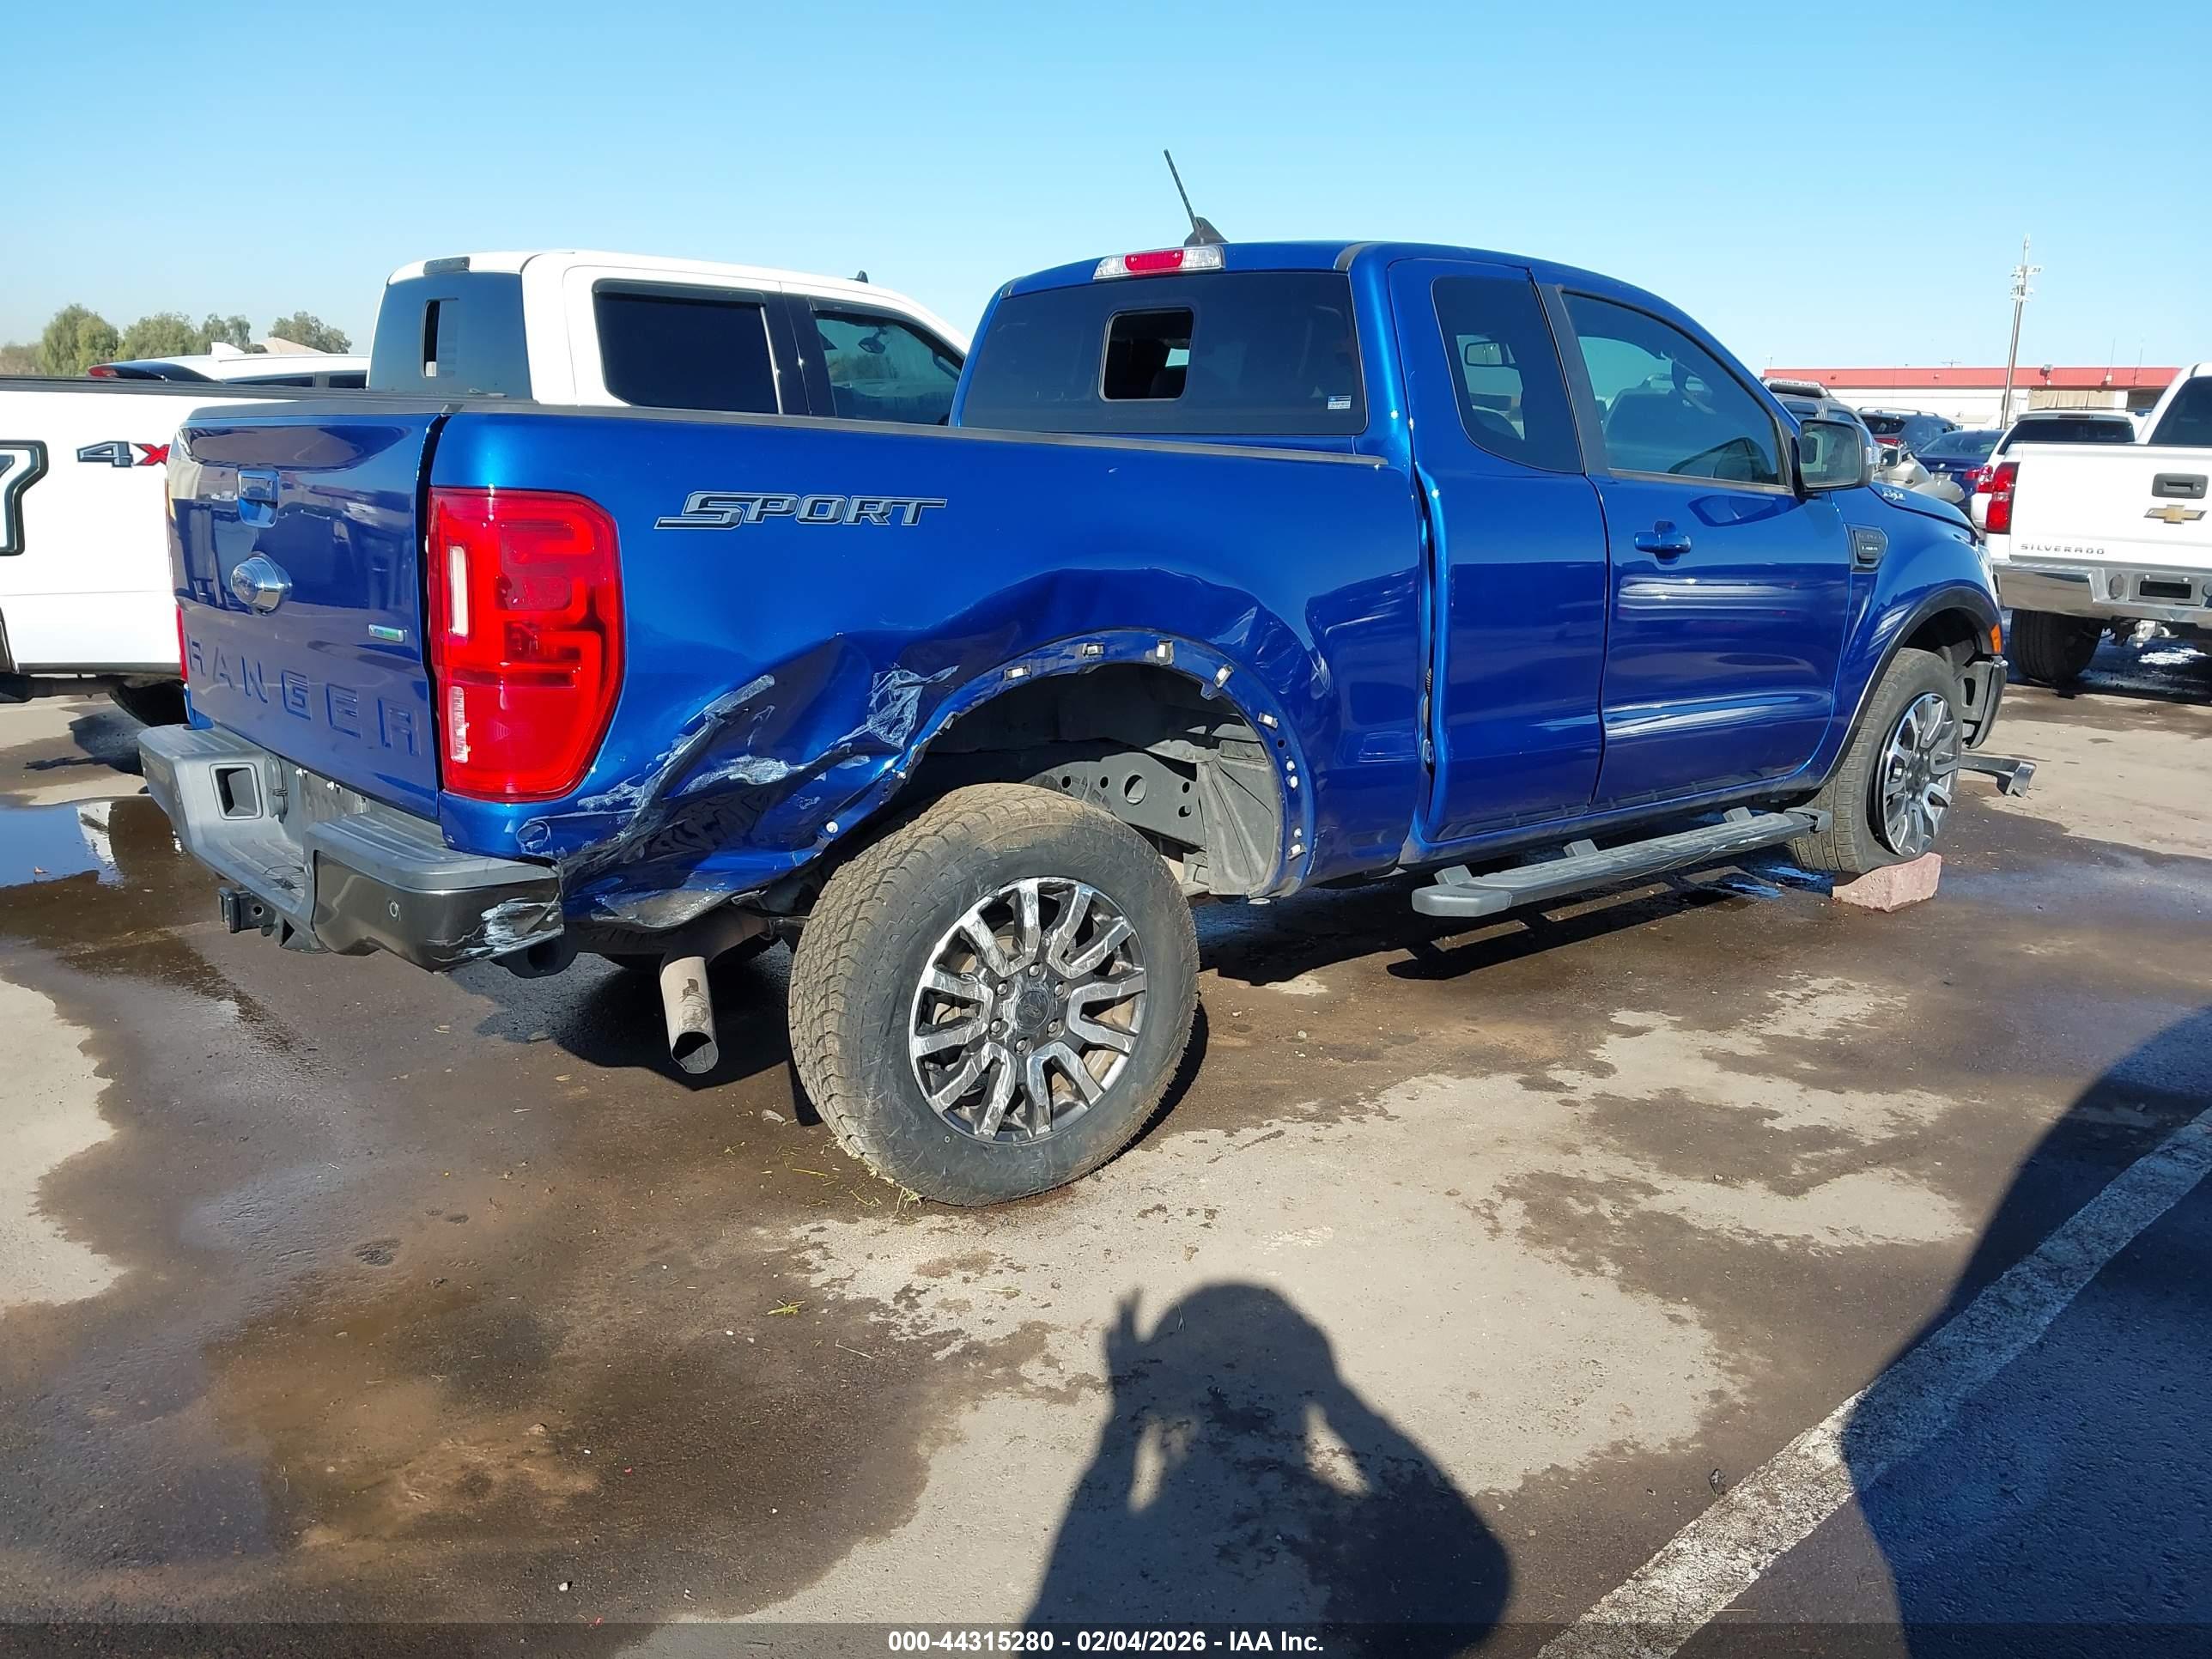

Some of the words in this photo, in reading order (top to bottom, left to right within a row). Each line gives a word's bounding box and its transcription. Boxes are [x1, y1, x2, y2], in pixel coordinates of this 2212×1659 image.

[653, 490, 948, 530] SPORT
[2020, 543, 2106, 555] SILVERADO
[186, 634, 422, 757] RANGER
